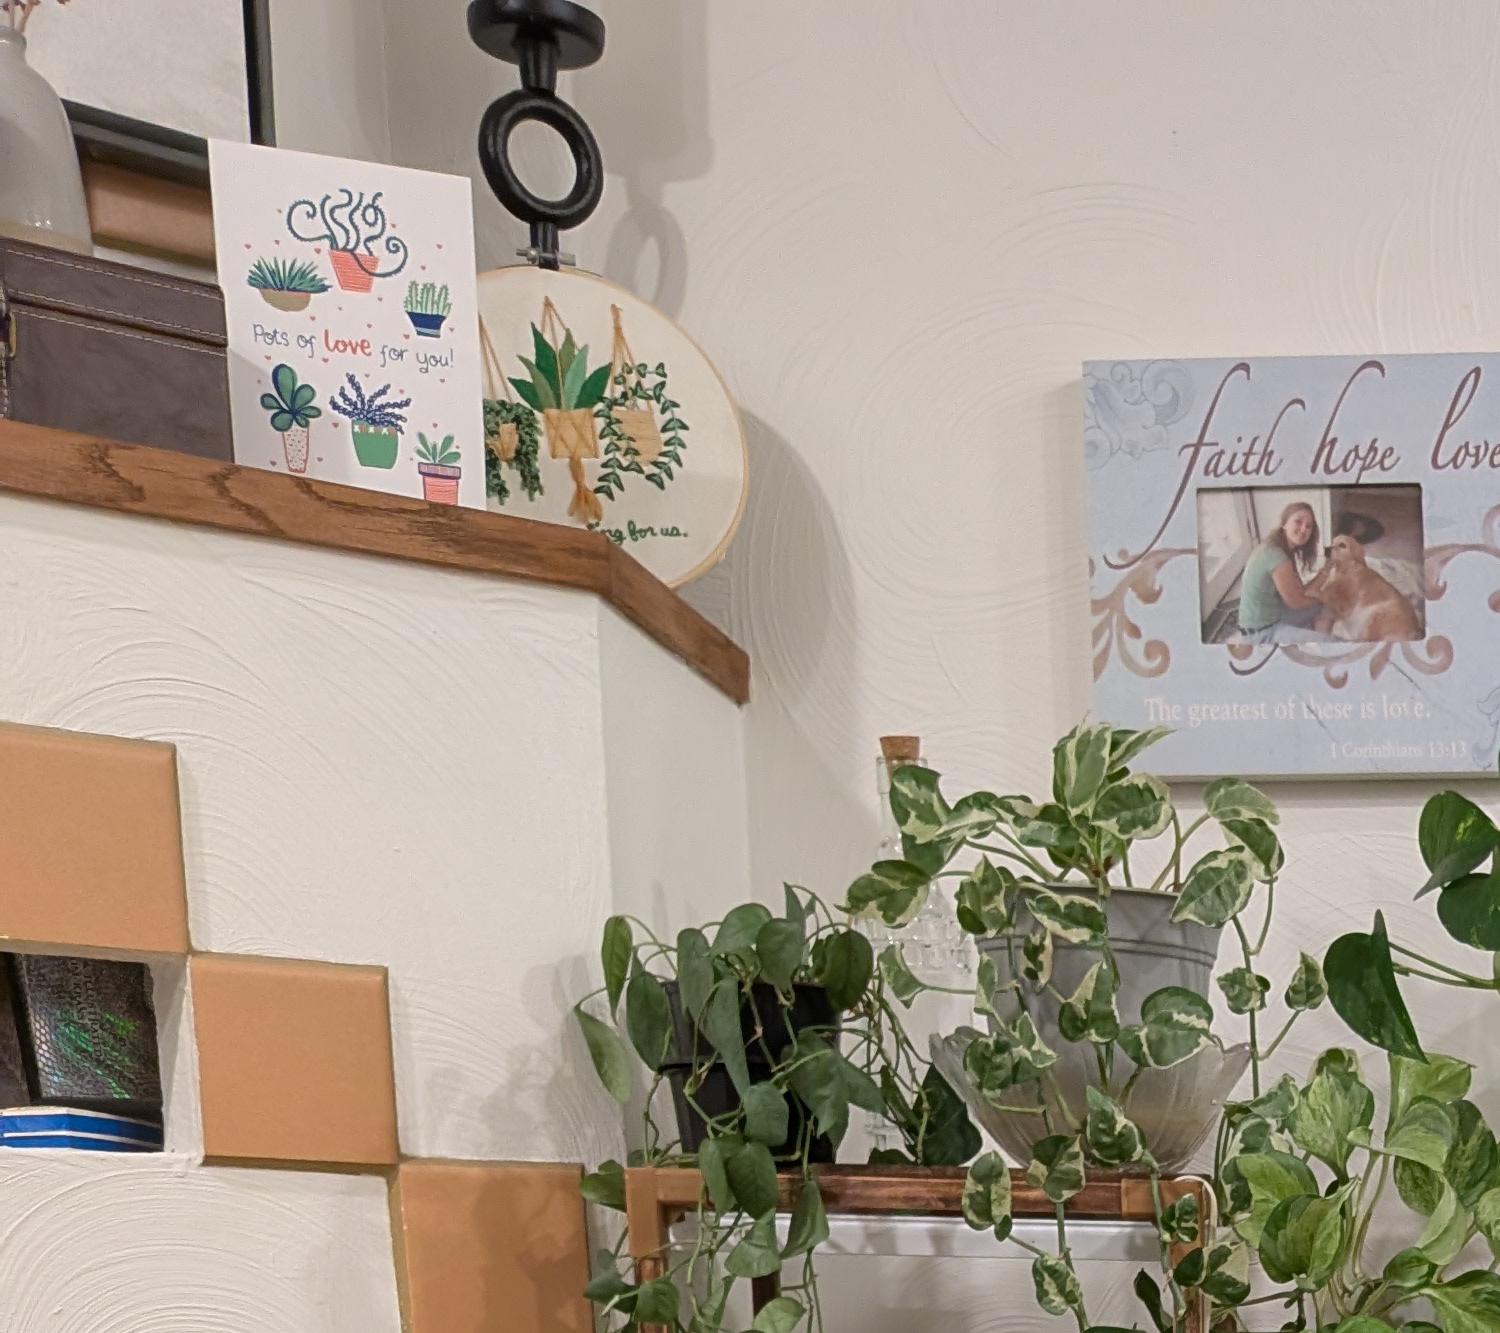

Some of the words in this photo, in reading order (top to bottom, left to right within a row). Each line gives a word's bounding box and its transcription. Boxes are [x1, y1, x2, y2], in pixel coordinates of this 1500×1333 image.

[253, 323, 289, 347] Pots
[297, 335, 316, 358] of
[324, 329, 372, 356] love
[380, 345, 408, 367] for
[416, 349, 454, 373] you!
[1103, 362, 1305, 570] faith
[1310, 360, 1400, 485] hope
[627, 520, 657, 542] for
[661, 526, 688, 538] us.
[1144, 697, 1182, 722] The
[1187, 700, 1267, 728] greatest
[1274, 697, 1297, 720] of
[1303, 698, 1353, 721] these
[1359, 696, 1376, 720] is
[1342, 741, 1423, 759] Corinthians
